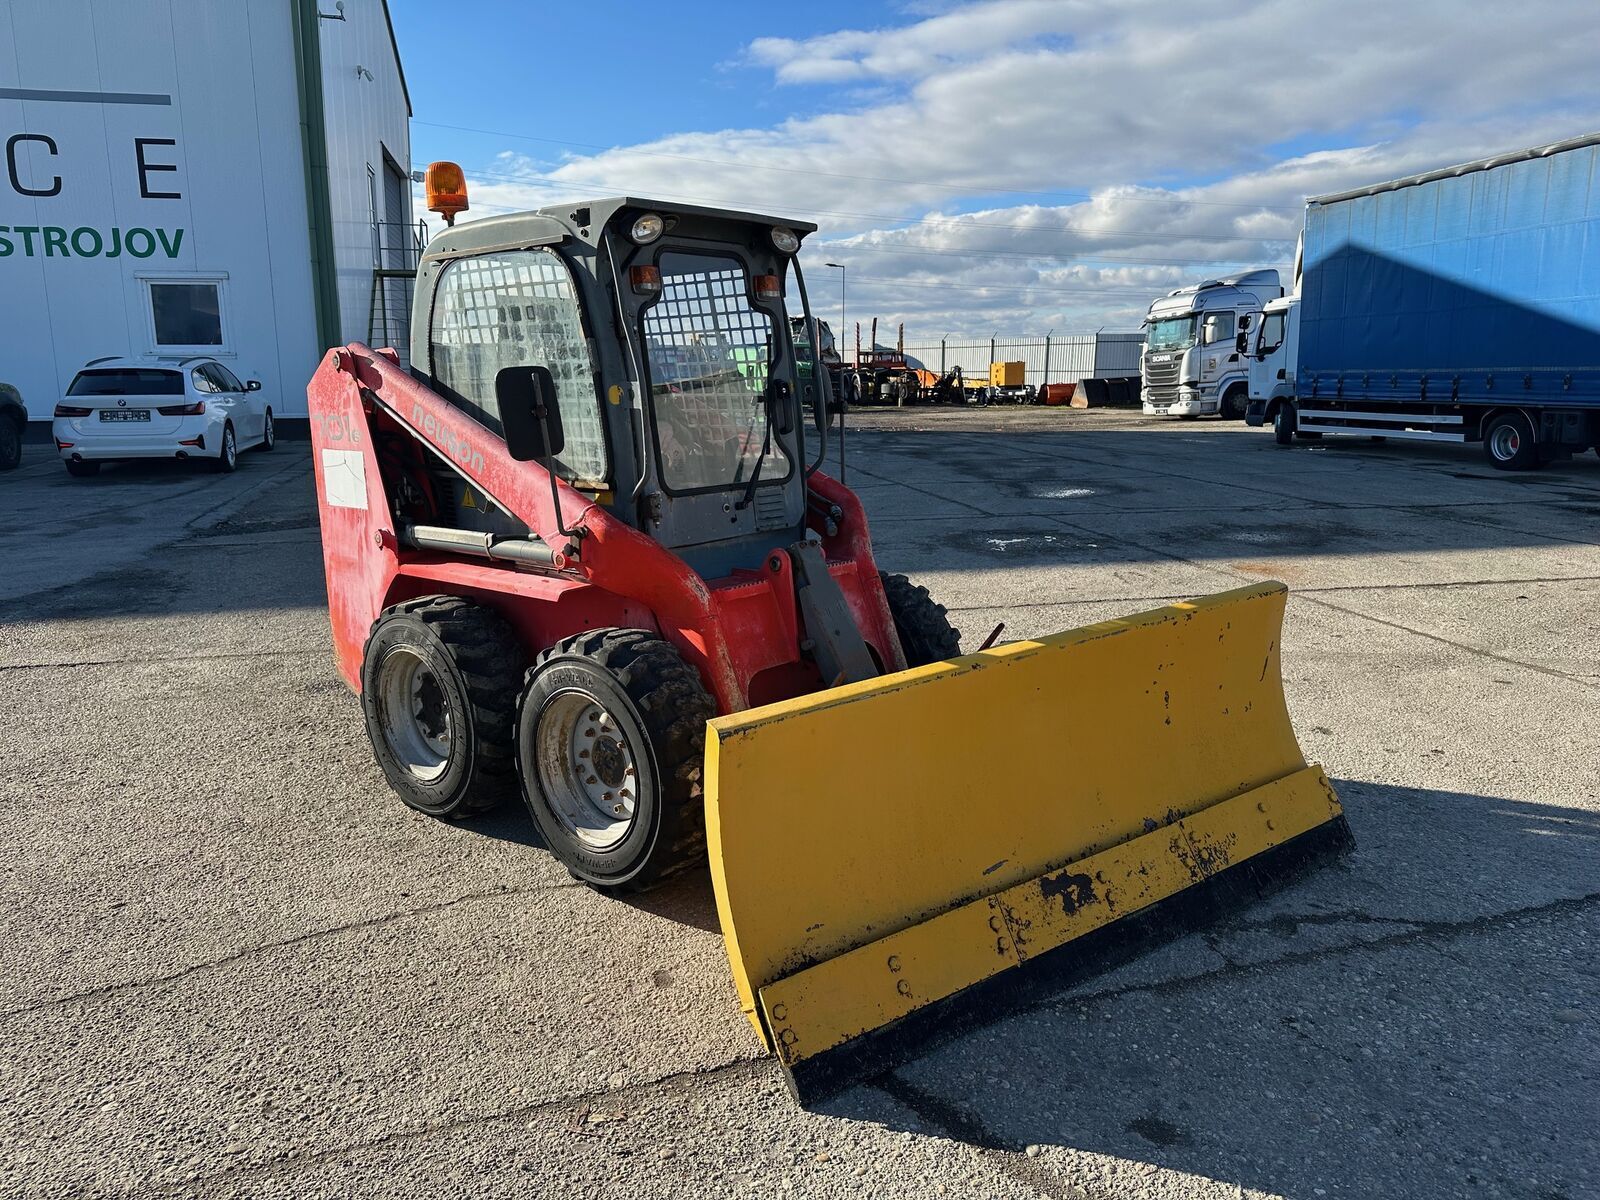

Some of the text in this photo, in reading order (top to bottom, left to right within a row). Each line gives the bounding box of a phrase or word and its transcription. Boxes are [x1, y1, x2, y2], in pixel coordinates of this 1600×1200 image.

[0, 225, 184, 259] STROJOV
[1152, 354, 1171, 362] SCANIA
[412, 403, 484, 474] neuson
